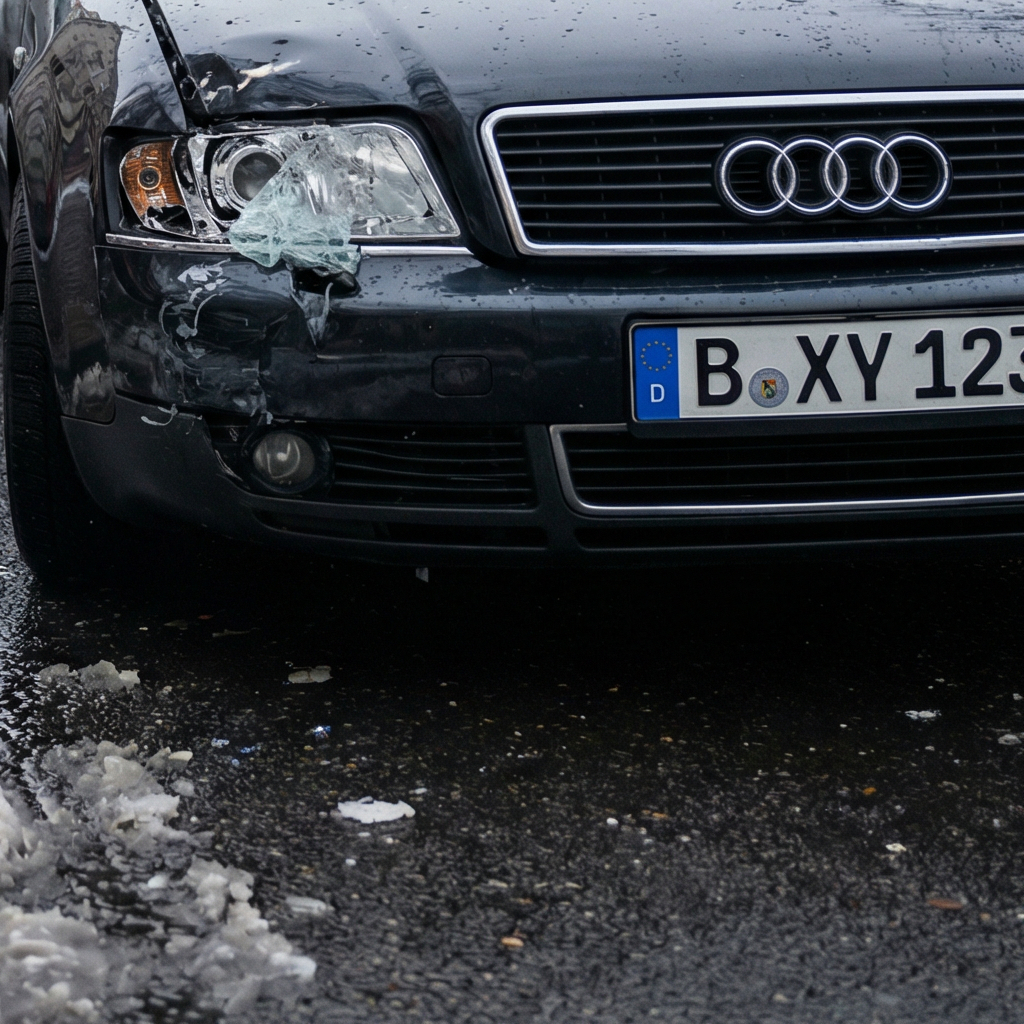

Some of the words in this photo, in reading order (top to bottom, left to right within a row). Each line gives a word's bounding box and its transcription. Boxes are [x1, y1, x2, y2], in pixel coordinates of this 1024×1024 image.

[650, 383, 665, 403] D
[695, 338, 743, 407] B
[796, 332, 892, 403] XY
